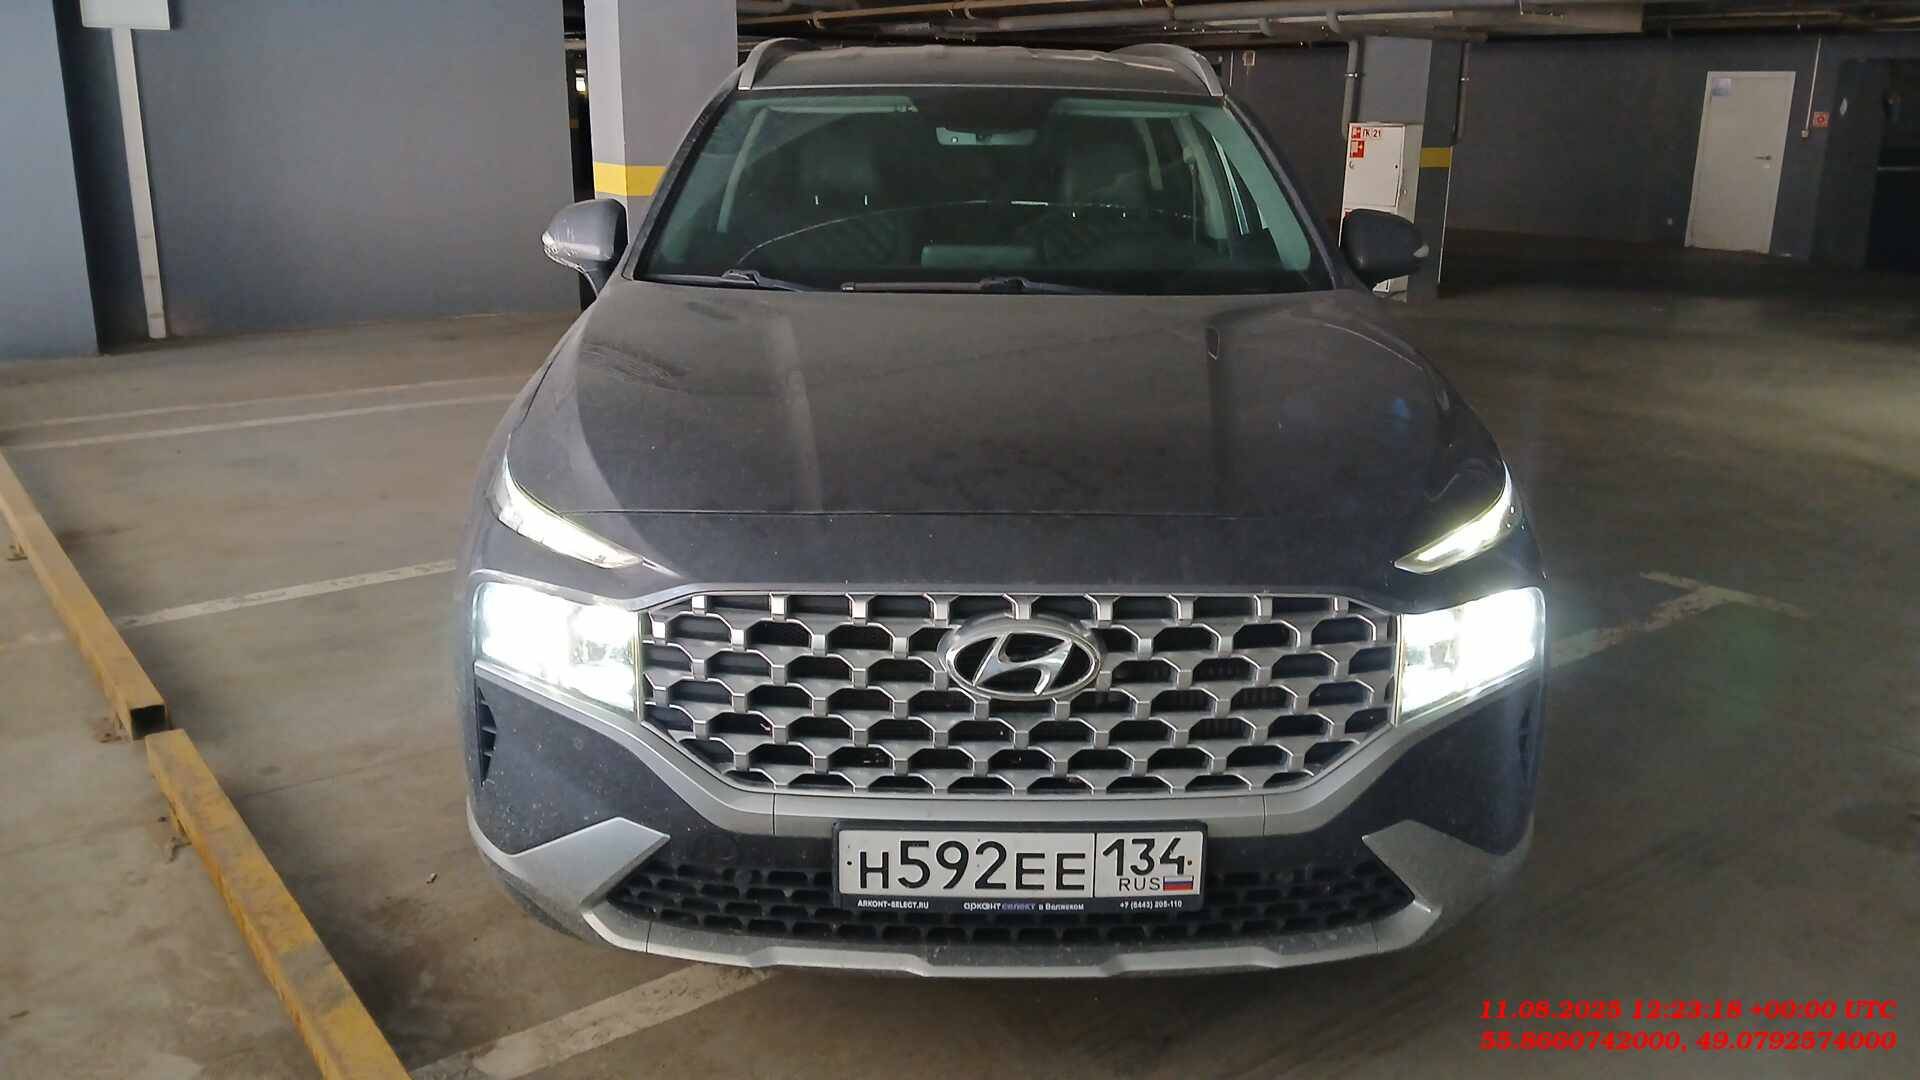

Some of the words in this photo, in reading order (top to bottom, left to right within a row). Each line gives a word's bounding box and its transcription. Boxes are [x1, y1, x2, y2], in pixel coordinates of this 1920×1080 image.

[1103, 837, 1185, 876] 134
[1119, 877, 1160, 891] RUS
[858, 900, 929, 909] ARKONT-SELECT.RU
